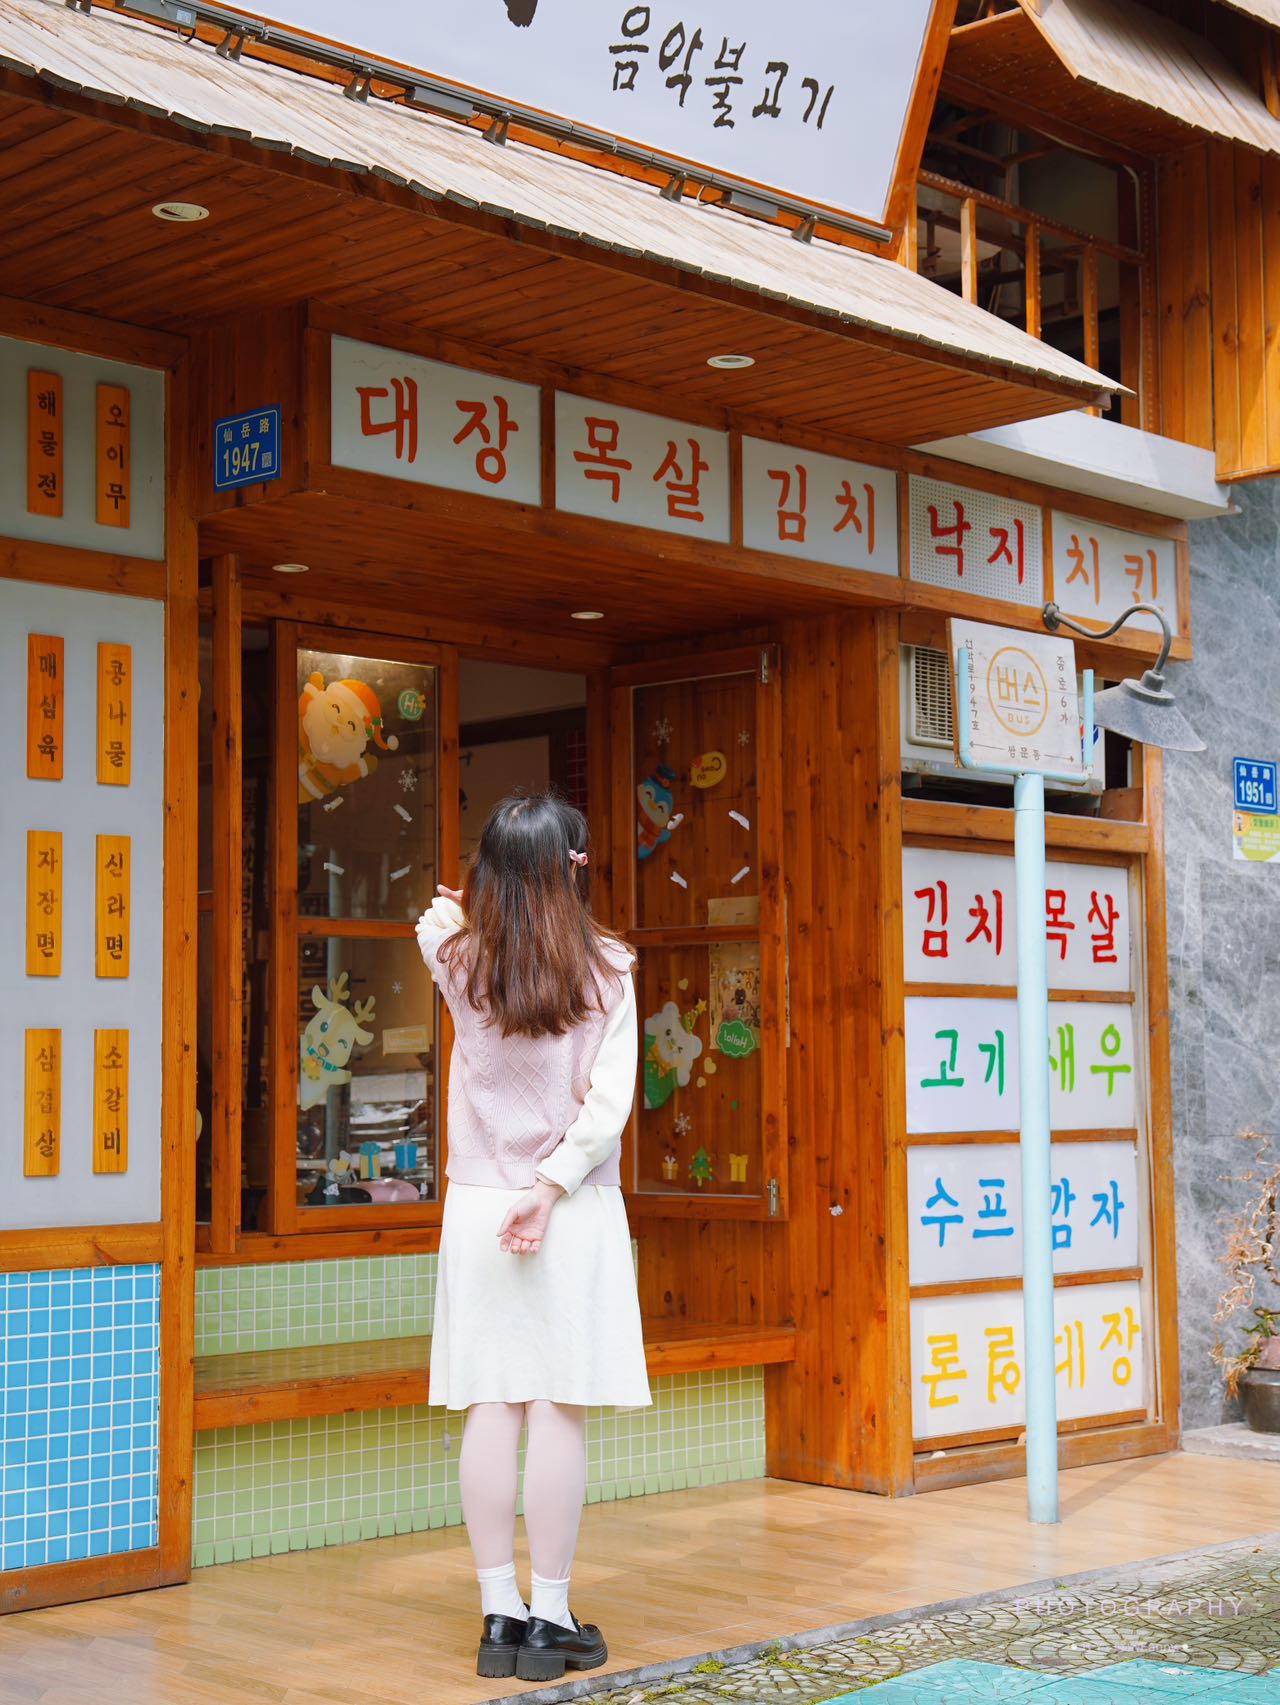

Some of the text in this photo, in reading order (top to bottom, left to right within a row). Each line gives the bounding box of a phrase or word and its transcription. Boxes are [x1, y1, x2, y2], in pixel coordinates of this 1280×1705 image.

[37, 390, 57, 498] 해물전
[106, 404, 126, 509] 오이무
[223, 442, 260, 477] 1947
[224, 417, 269, 444] 仙岳路
[355, 376, 519, 484] 대장
[573, 416, 709, 522] 목살
[767, 464, 874, 555] 김치
[928, 501, 1024, 585] 낙지
[105, 660, 126, 767] 콩나물
[996, 666, 1040, 705] 버스
[1007, 713, 1032, 725] BUS
[1240, 780, 1264, 804] 1951
[37, 847, 58, 958] 자장면
[105, 852, 125, 960] 신라면
[914, 880, 1120, 963] 김치 목살
[35, 1045, 56, 1158] 삼겹살
[103, 1045, 124, 1155] 소갈비
[920, 1029, 1004, 1096] 고기
[920, 1177, 1014, 1248] 수프
